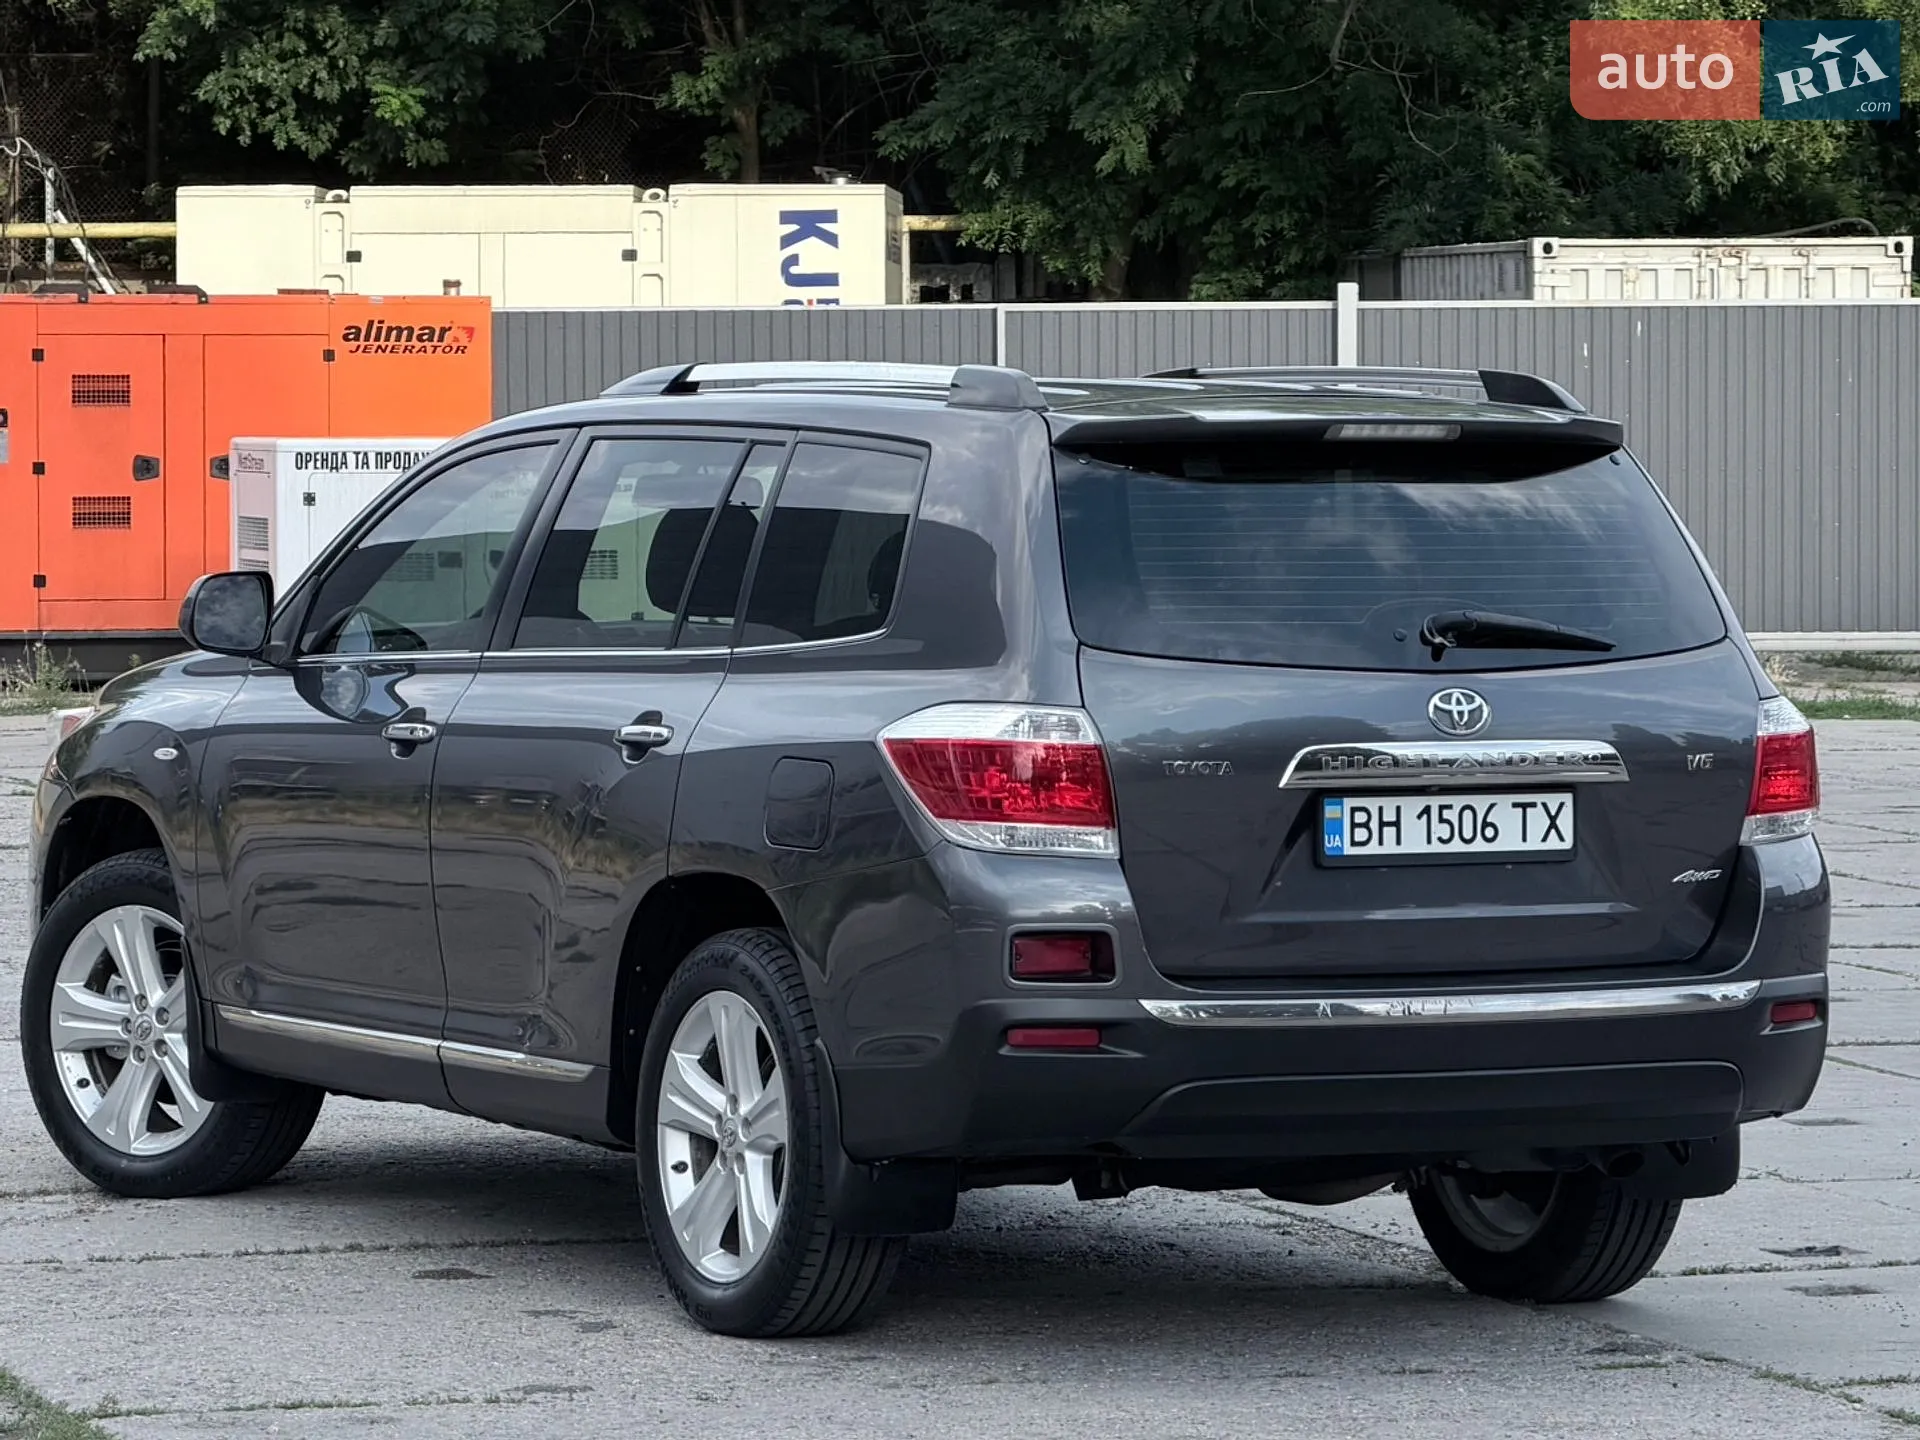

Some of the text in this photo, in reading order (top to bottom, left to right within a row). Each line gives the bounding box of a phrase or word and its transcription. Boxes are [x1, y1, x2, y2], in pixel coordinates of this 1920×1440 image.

[341, 319, 452, 342] alimar
[294, 451, 348, 473] ОРЕНДА
[353, 451, 370, 470] ТА
[1162, 760, 1234, 776] TOYOTA
[1321, 751, 1588, 772] HIGHLANDER
[1686, 753, 1714, 771] V6
[1349, 801, 1567, 847] BH 1506 TX
[1325, 834, 1342, 848] UA
